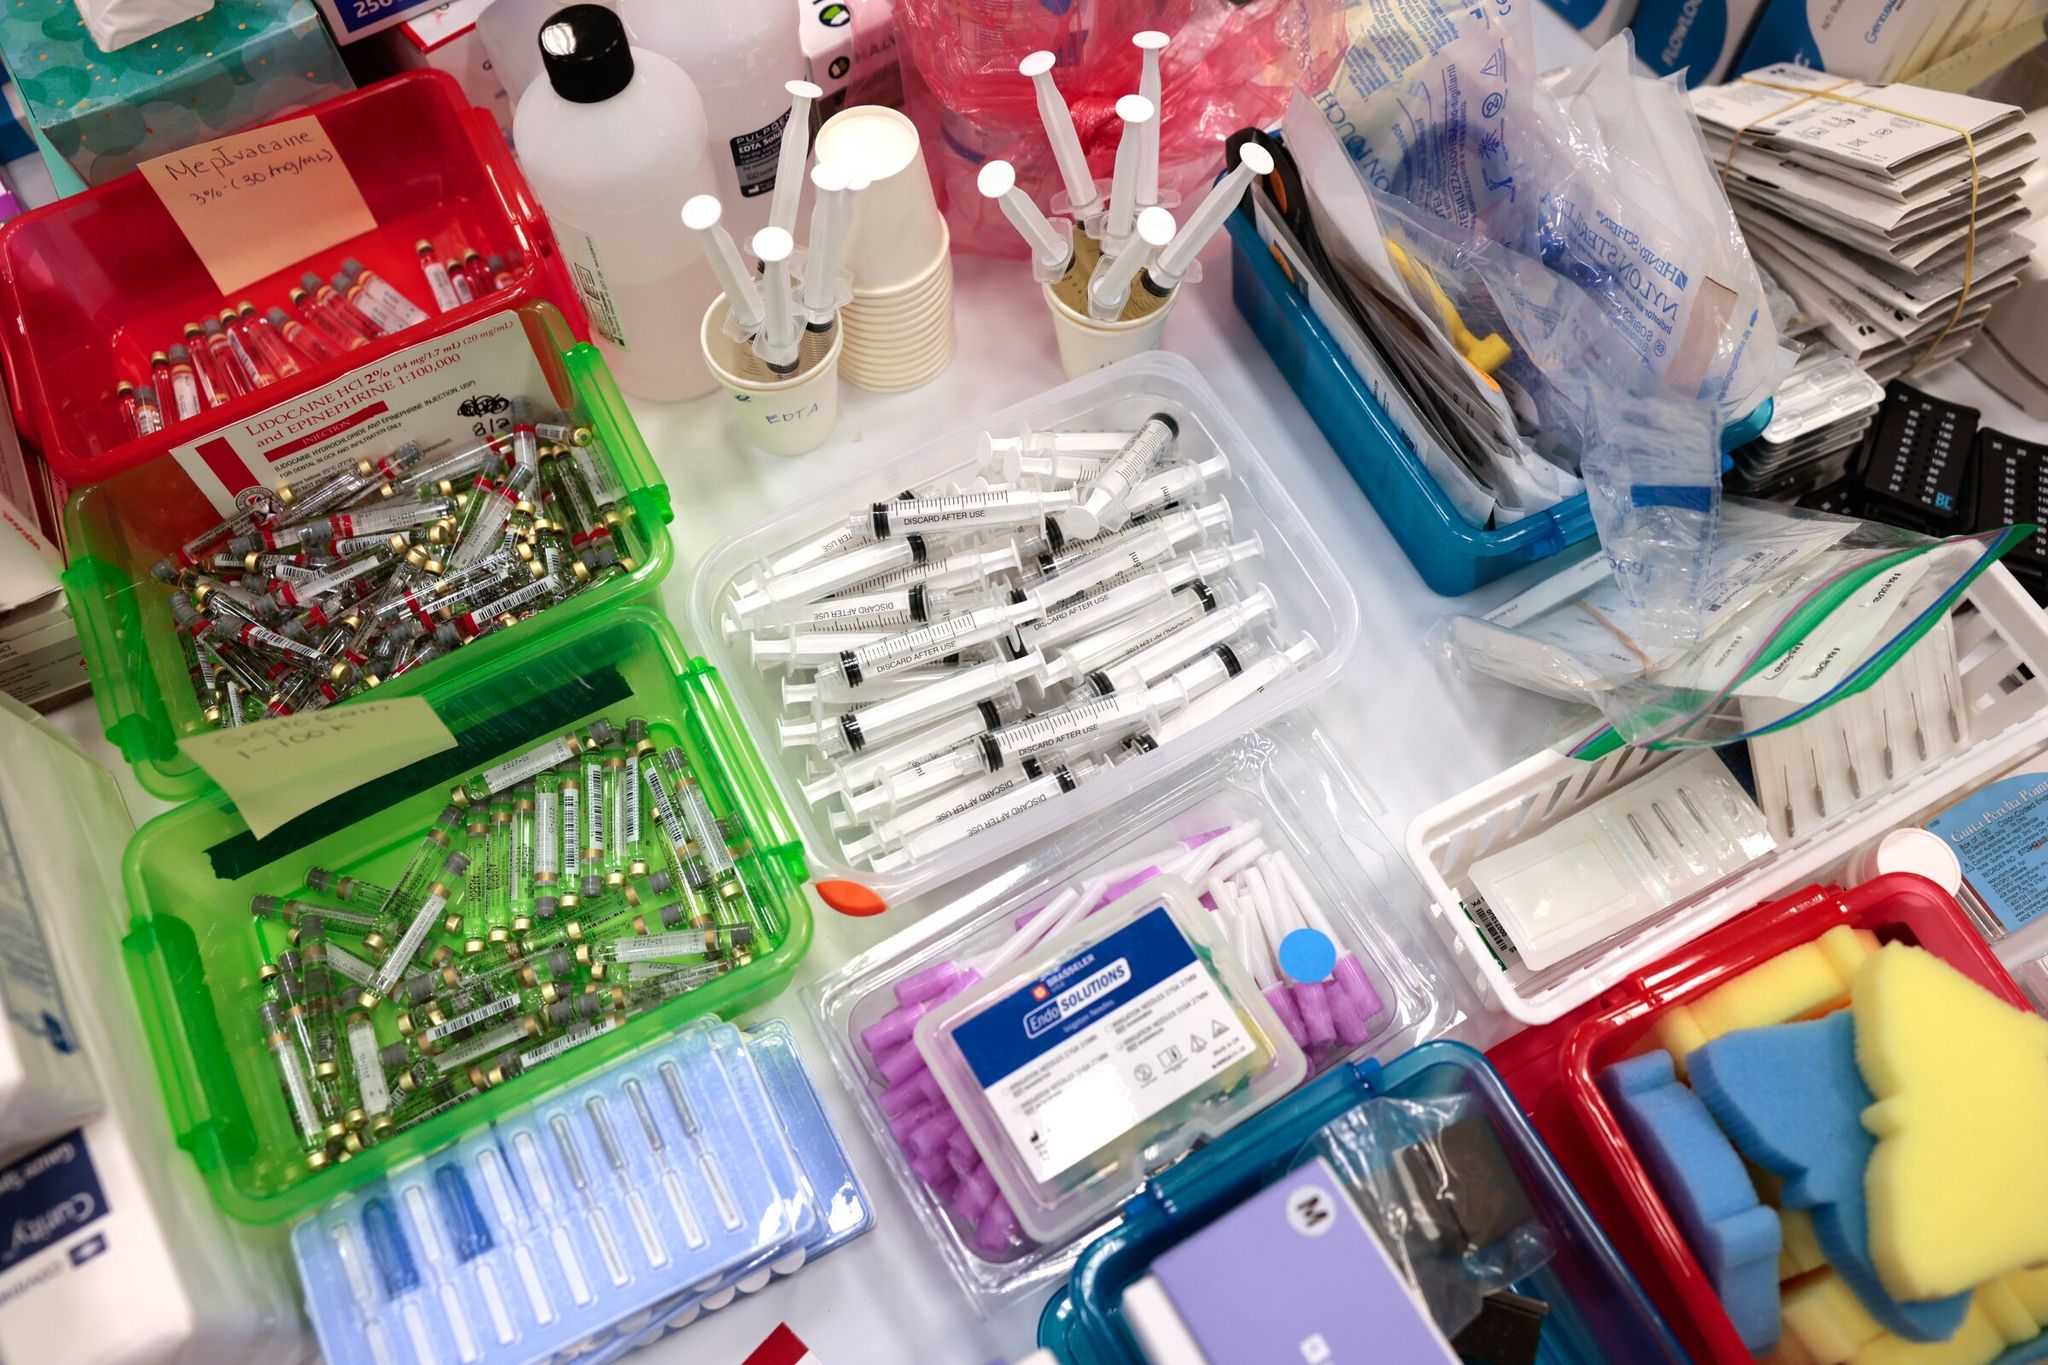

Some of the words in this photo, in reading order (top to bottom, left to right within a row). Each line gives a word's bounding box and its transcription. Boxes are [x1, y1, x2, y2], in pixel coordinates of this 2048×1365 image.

[739, 141, 761, 153] EDTA
[244, 392, 335, 437] LIDOCAINE
[364, 367, 390, 387] 2%
[393, 361, 408, 374] (34
[443, 341, 461, 355] mL)
[463, 334, 477, 347] (20
[480, 320, 514, 340] mg/mL)
[256, 430, 284, 449] and
[289, 382, 396, 434] EPINEPHRINE
[398, 352, 461, 386] 1:100,000
[766, 403, 819, 425] EDTA
[274, 452, 312, 472] (LIDOCAINE
[312, 428, 367, 455] HYDROCHLORIDE
[382, 402, 423, 426] EPINEPHRINE
[302, 419, 351, 445] INJECTION
[280, 469, 292, 479] FOR
[293, 460, 314, 475] DENTAL
[315, 452, 337, 465] BLOCK
[337, 446, 350, 457] AND
[349, 429, 387, 451] INFILTRATION
[388, 422, 403, 433] ONLY
[904, 514, 940, 526] DISCARD
[941, 512, 968, 522] AFTER
[969, 510, 986, 518] USE
[823, 541, 837, 552] USE
[838, 531, 853, 545] TER
[831, 607, 856, 618] AFTER
[858, 602, 894, 614] DISCARD
[1068, 601, 1093, 616] AFTER
[1094, 593, 1110, 605] USE
[813, 612, 829, 621] USE
[877, 656, 912, 673] DISCARD
[914, 647, 939, 663] AFTER
[940, 640, 957, 651] USE
[1018, 740, 1054, 756] DISCARD
[1055, 729, 1082, 744] AFTER
[1083, 723, 1099, 734] USE
[979, 779, 1014, 804] DISCARD
[936, 810, 953, 823] USE
[954, 797, 978, 815] AFTER
[1012, 793, 1047, 817] DISCARD
[985, 809, 1010, 827] AFTER
[1950, 820, 1983, 841] Gutta
[1983, 797, 2020, 821] Percha
[967, 823, 984, 837] USE
[1046, 953, 1096, 988] BRASSELER
[1027, 1006, 1060, 1032] Endo
[1061, 964, 1126, 1011] SOLUTIONS
[1295, 1194, 1328, 1230] M
